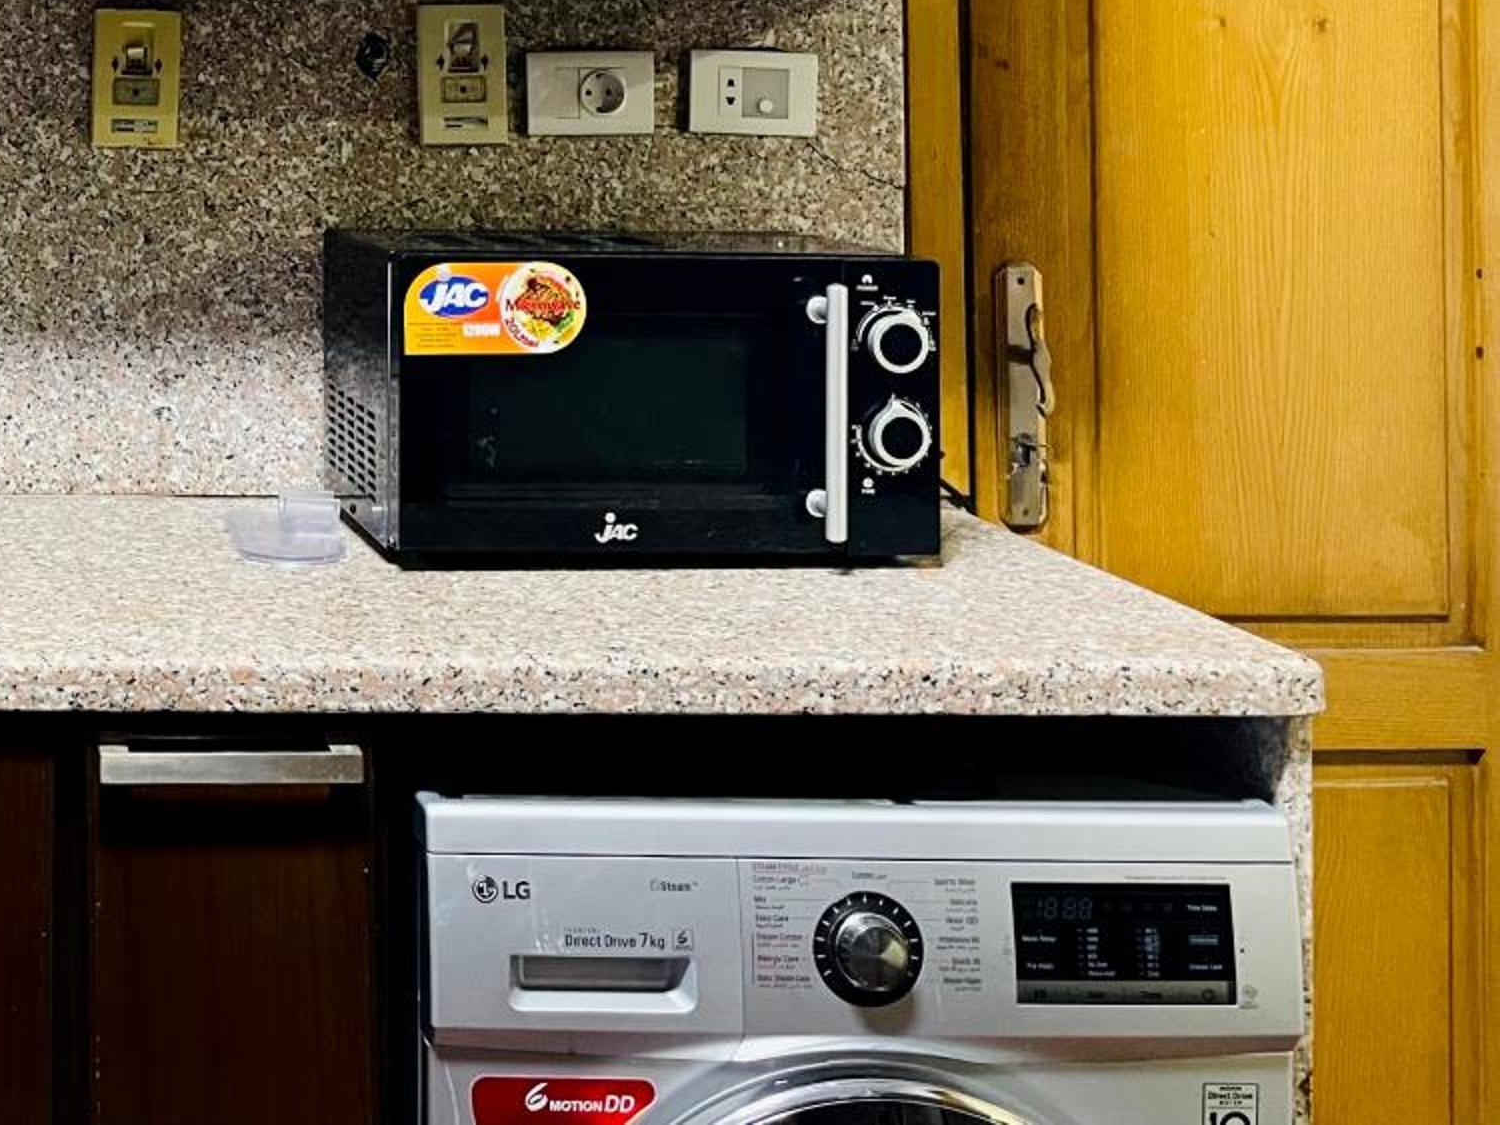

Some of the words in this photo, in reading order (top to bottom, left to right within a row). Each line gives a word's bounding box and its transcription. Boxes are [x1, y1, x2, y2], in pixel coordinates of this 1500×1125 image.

[502, 880, 531, 900] LG
[565, 934, 601, 948] Direct
[604, 934, 637, 948] Drive
[525, 1082, 549, 1112] 6
[550, 1100, 602, 1112] MOTION
[604, 1094, 636, 1113] DD
